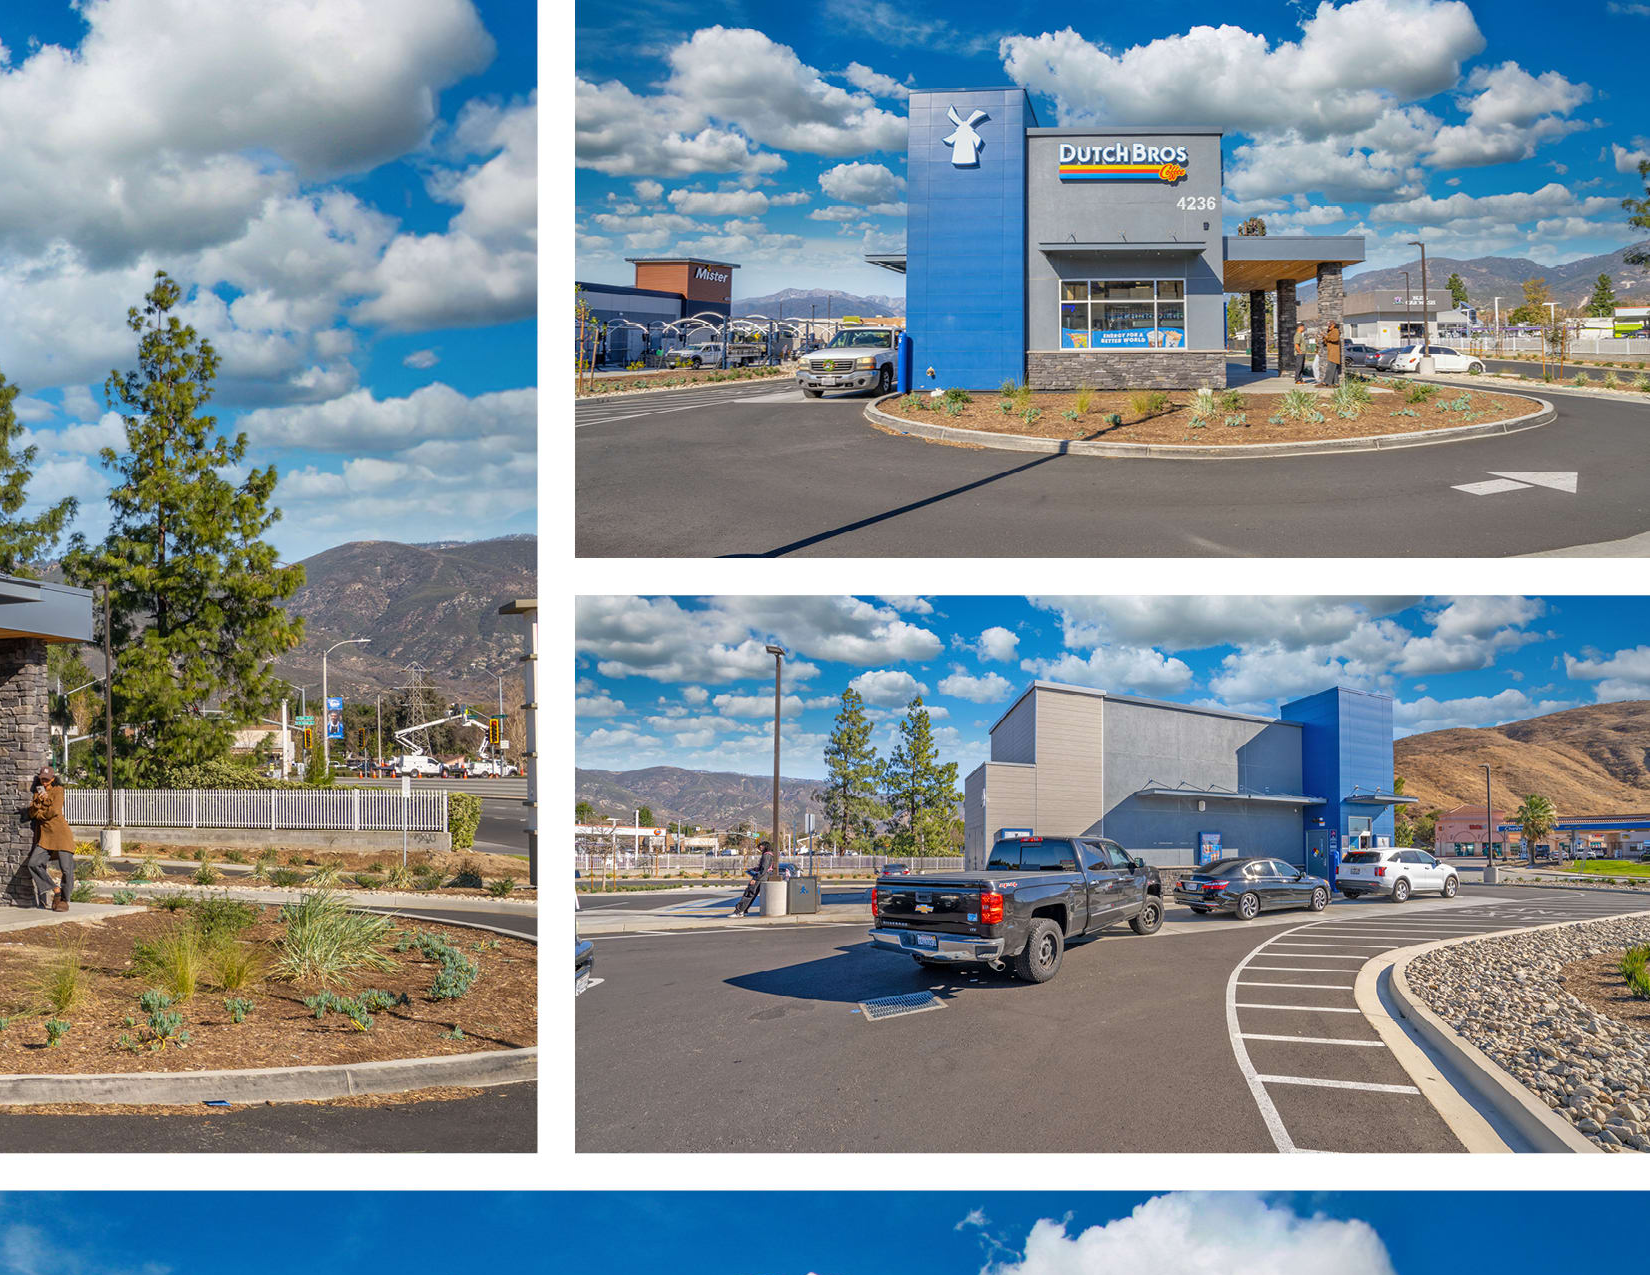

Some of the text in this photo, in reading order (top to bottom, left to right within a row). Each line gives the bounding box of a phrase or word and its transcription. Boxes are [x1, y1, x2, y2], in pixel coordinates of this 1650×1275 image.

[1132, 143, 1187, 163] BROS
[1159, 163, 1186, 181] Coffee
[1177, 196, 1216, 210] 4236
[695, 267, 728, 283] Mister
